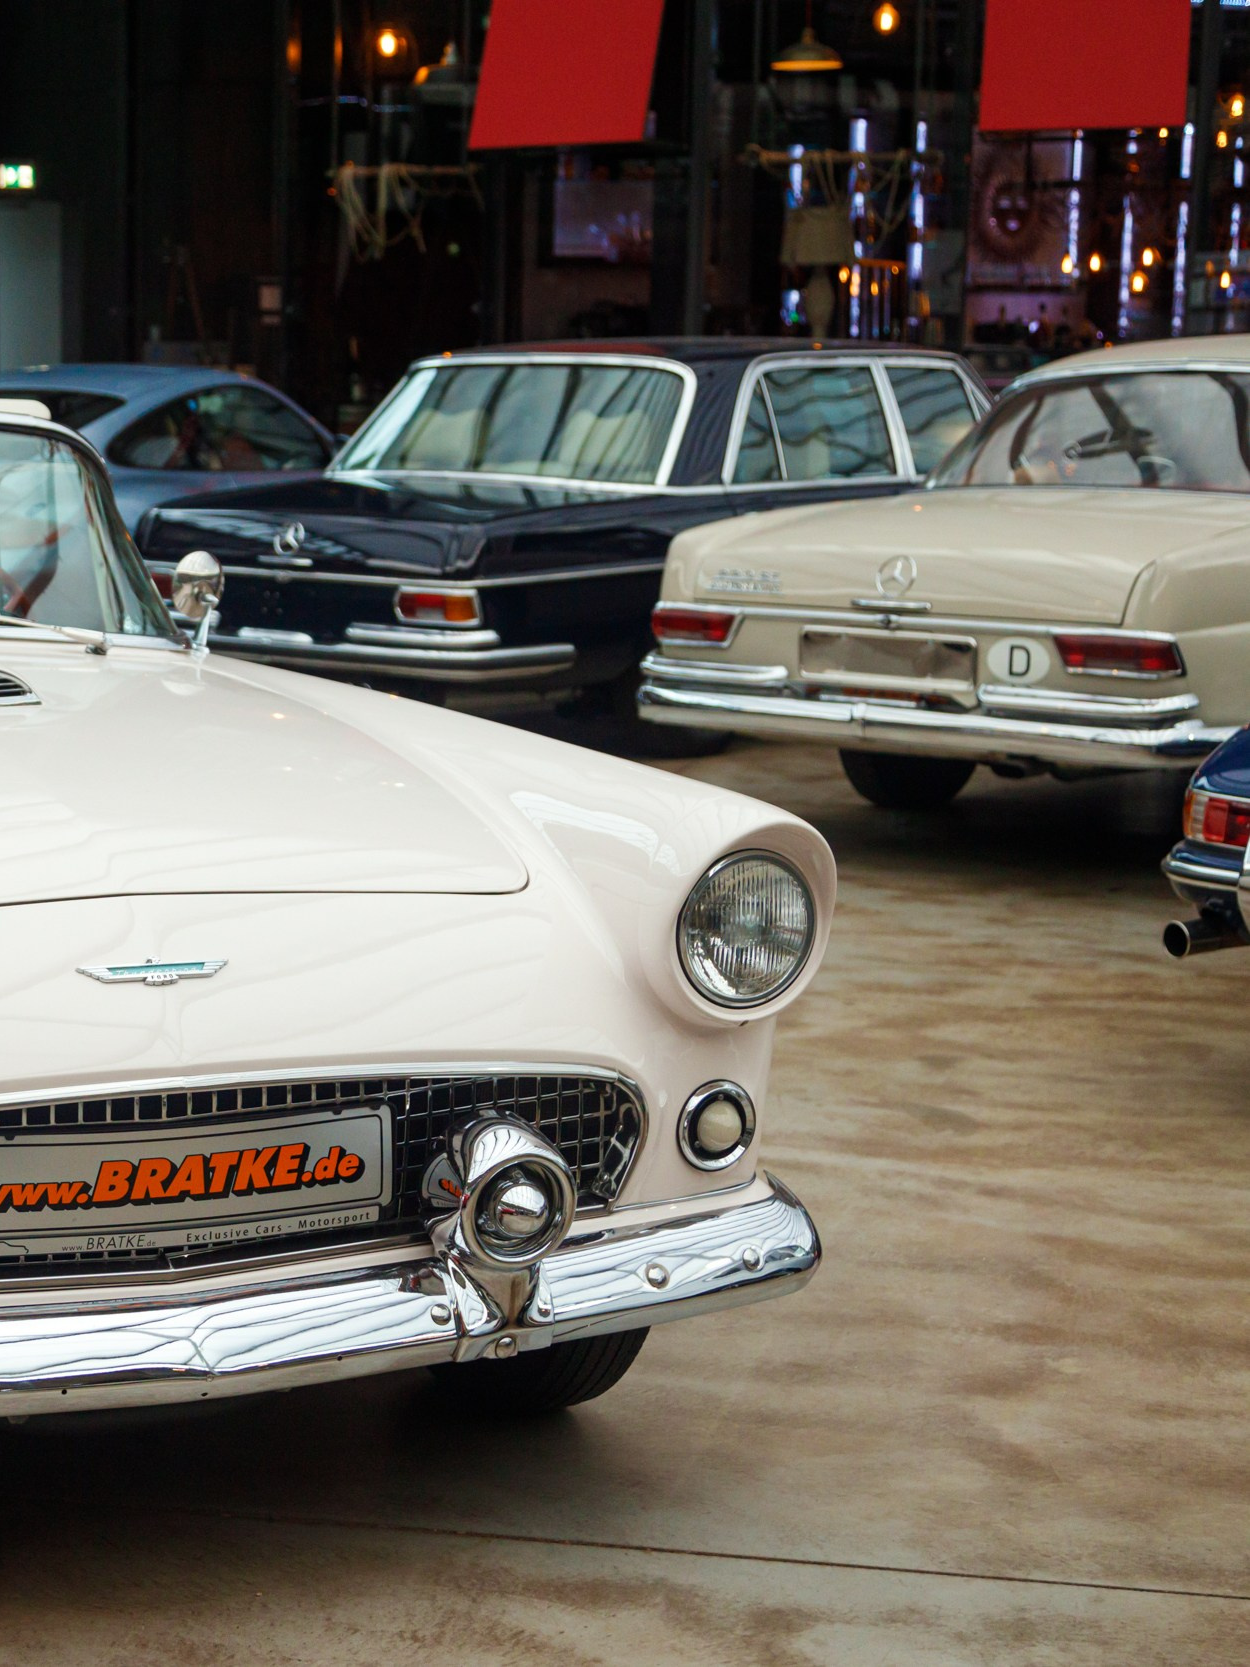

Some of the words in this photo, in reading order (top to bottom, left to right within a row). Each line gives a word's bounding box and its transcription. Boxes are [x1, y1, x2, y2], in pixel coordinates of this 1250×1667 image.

[1009, 644, 1031, 677] D
[62, 1234, 157, 1251] www.BRATKE.de
[186, 1227, 250, 1243] Exclusive
[255, 1224, 283, 1236] Cars
[298, 1211, 371, 1230] Motorsport
